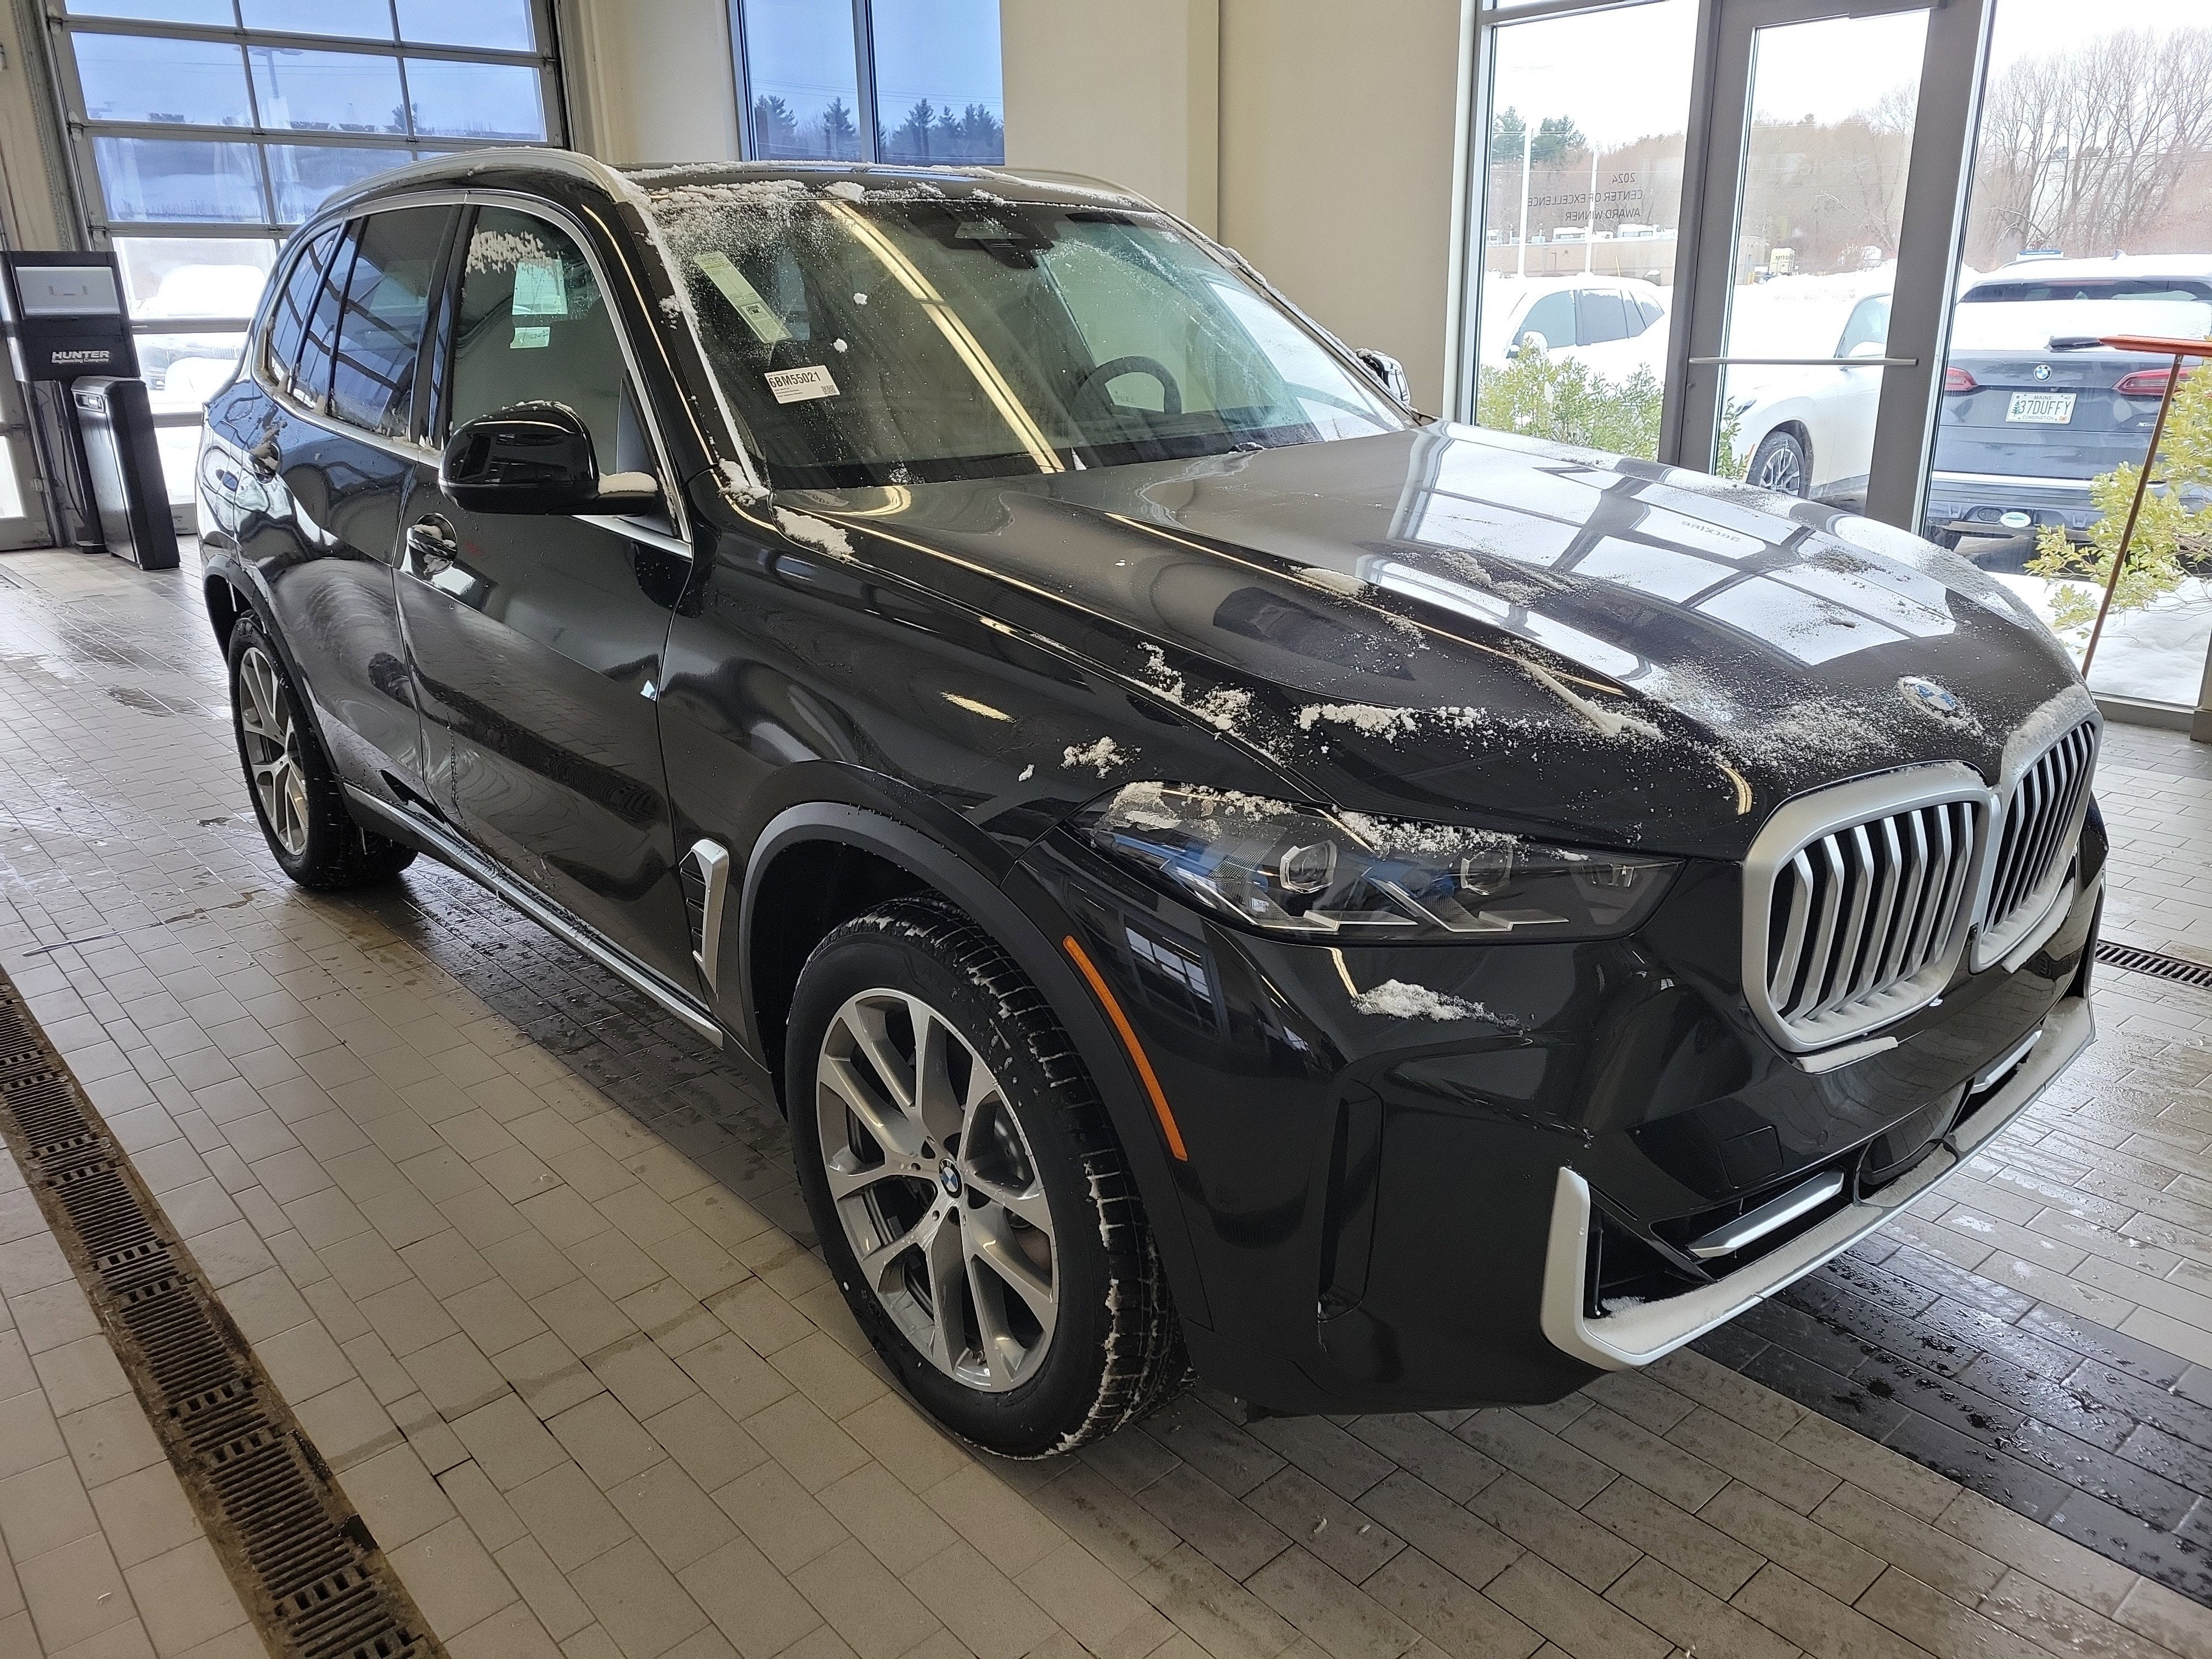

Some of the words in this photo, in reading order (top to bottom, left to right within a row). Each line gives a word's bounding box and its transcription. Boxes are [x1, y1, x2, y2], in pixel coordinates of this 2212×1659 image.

[52, 351, 110, 359] HUNTER
[768, 371, 821, 388] 6BM55021
[2019, 400, 2072, 415] 37DUFFY
